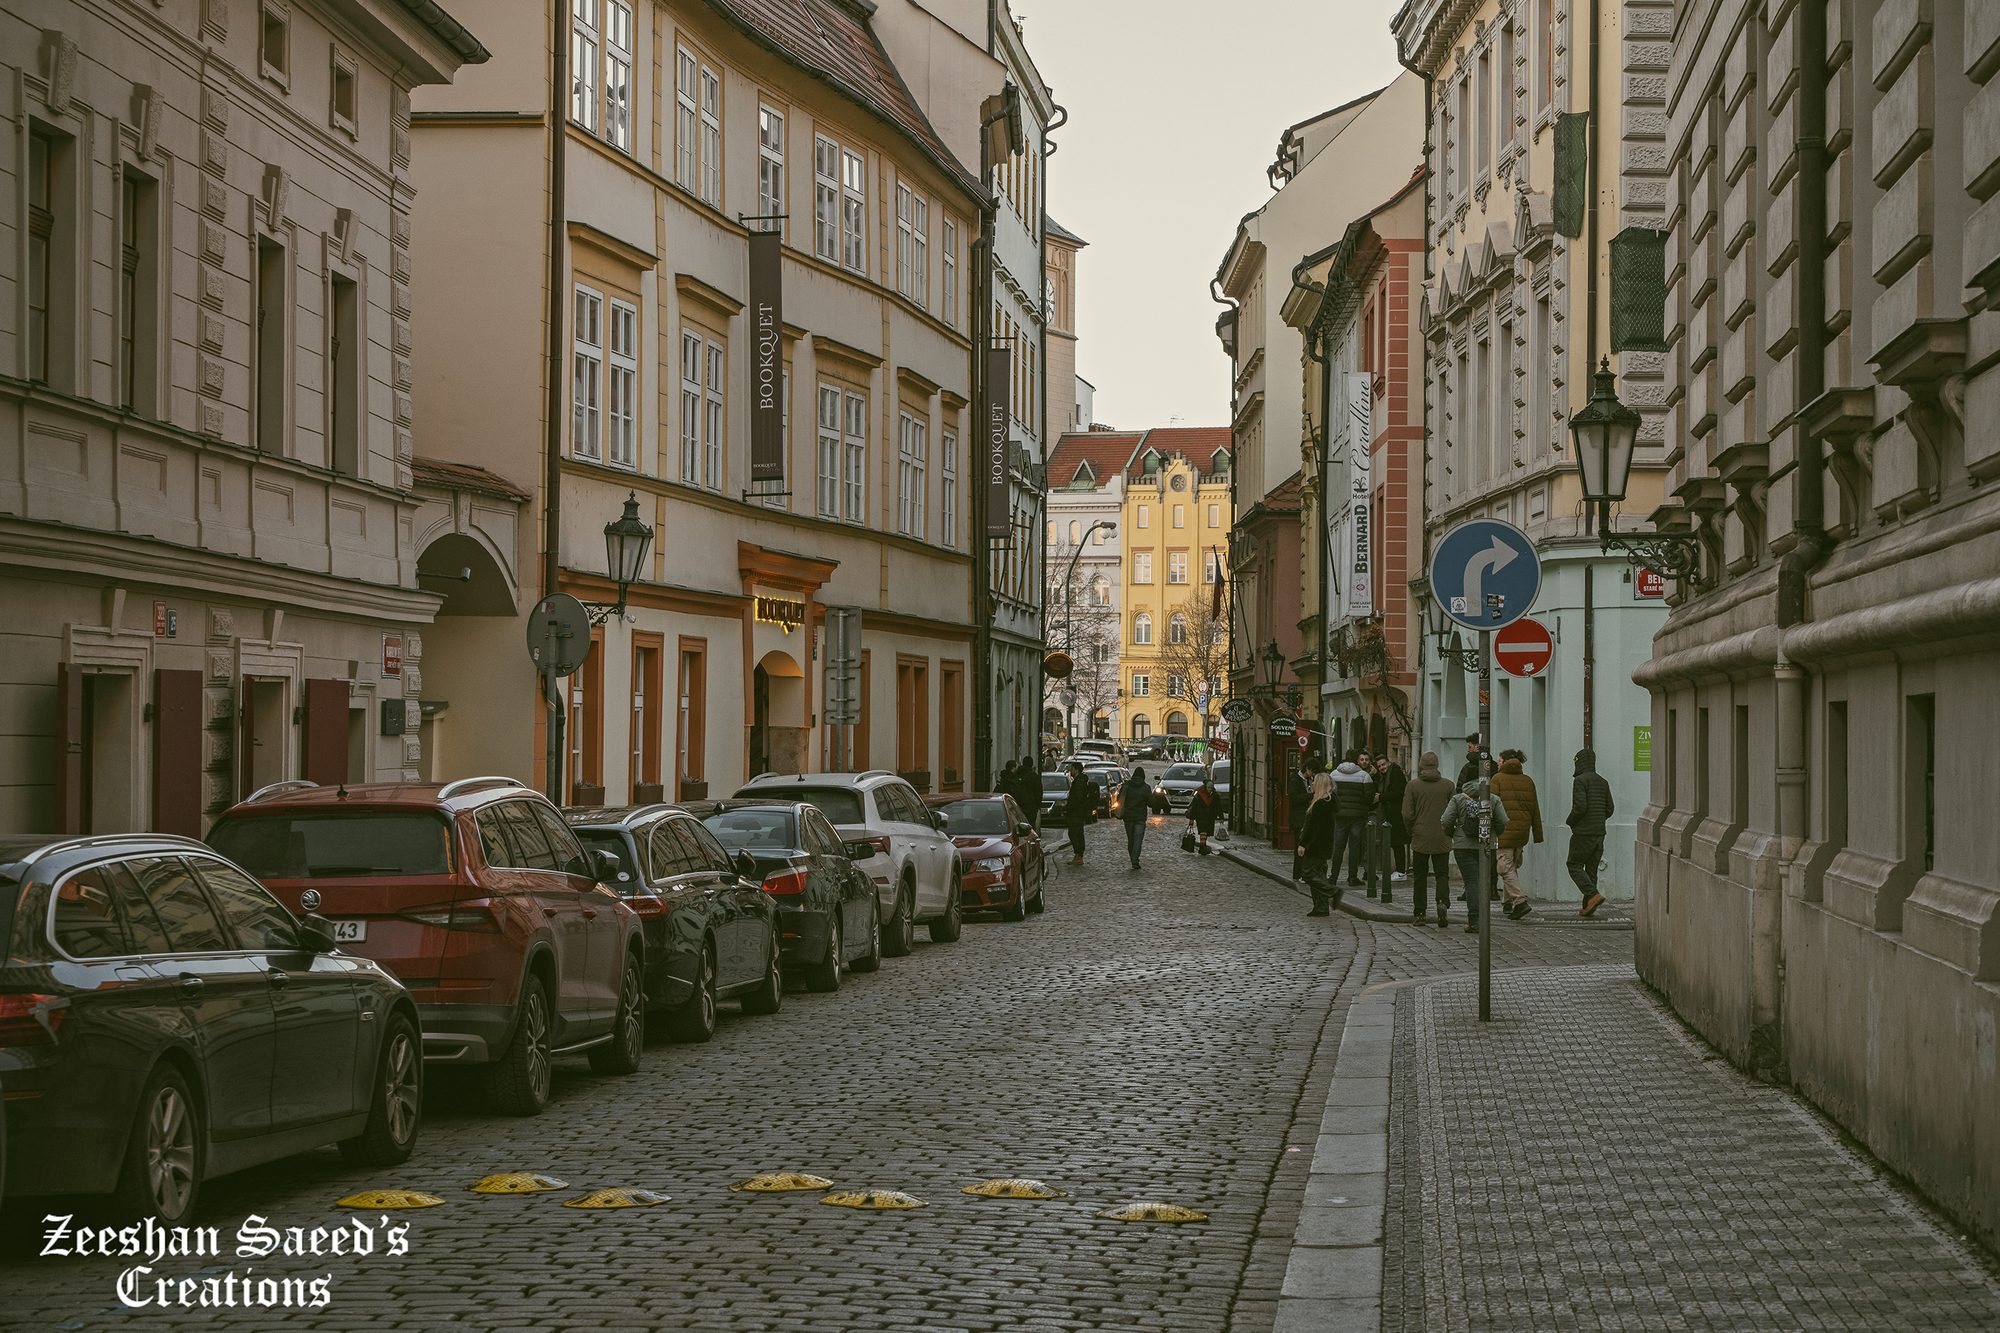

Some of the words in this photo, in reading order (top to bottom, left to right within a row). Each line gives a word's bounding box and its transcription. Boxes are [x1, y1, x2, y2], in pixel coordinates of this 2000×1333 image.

[759, 303, 779, 410] BOOKQUET
[992, 402, 1007, 484] BOOKQUET
[1354, 504, 1368, 574] BERNARD
[337, 922, 358, 939] 43
